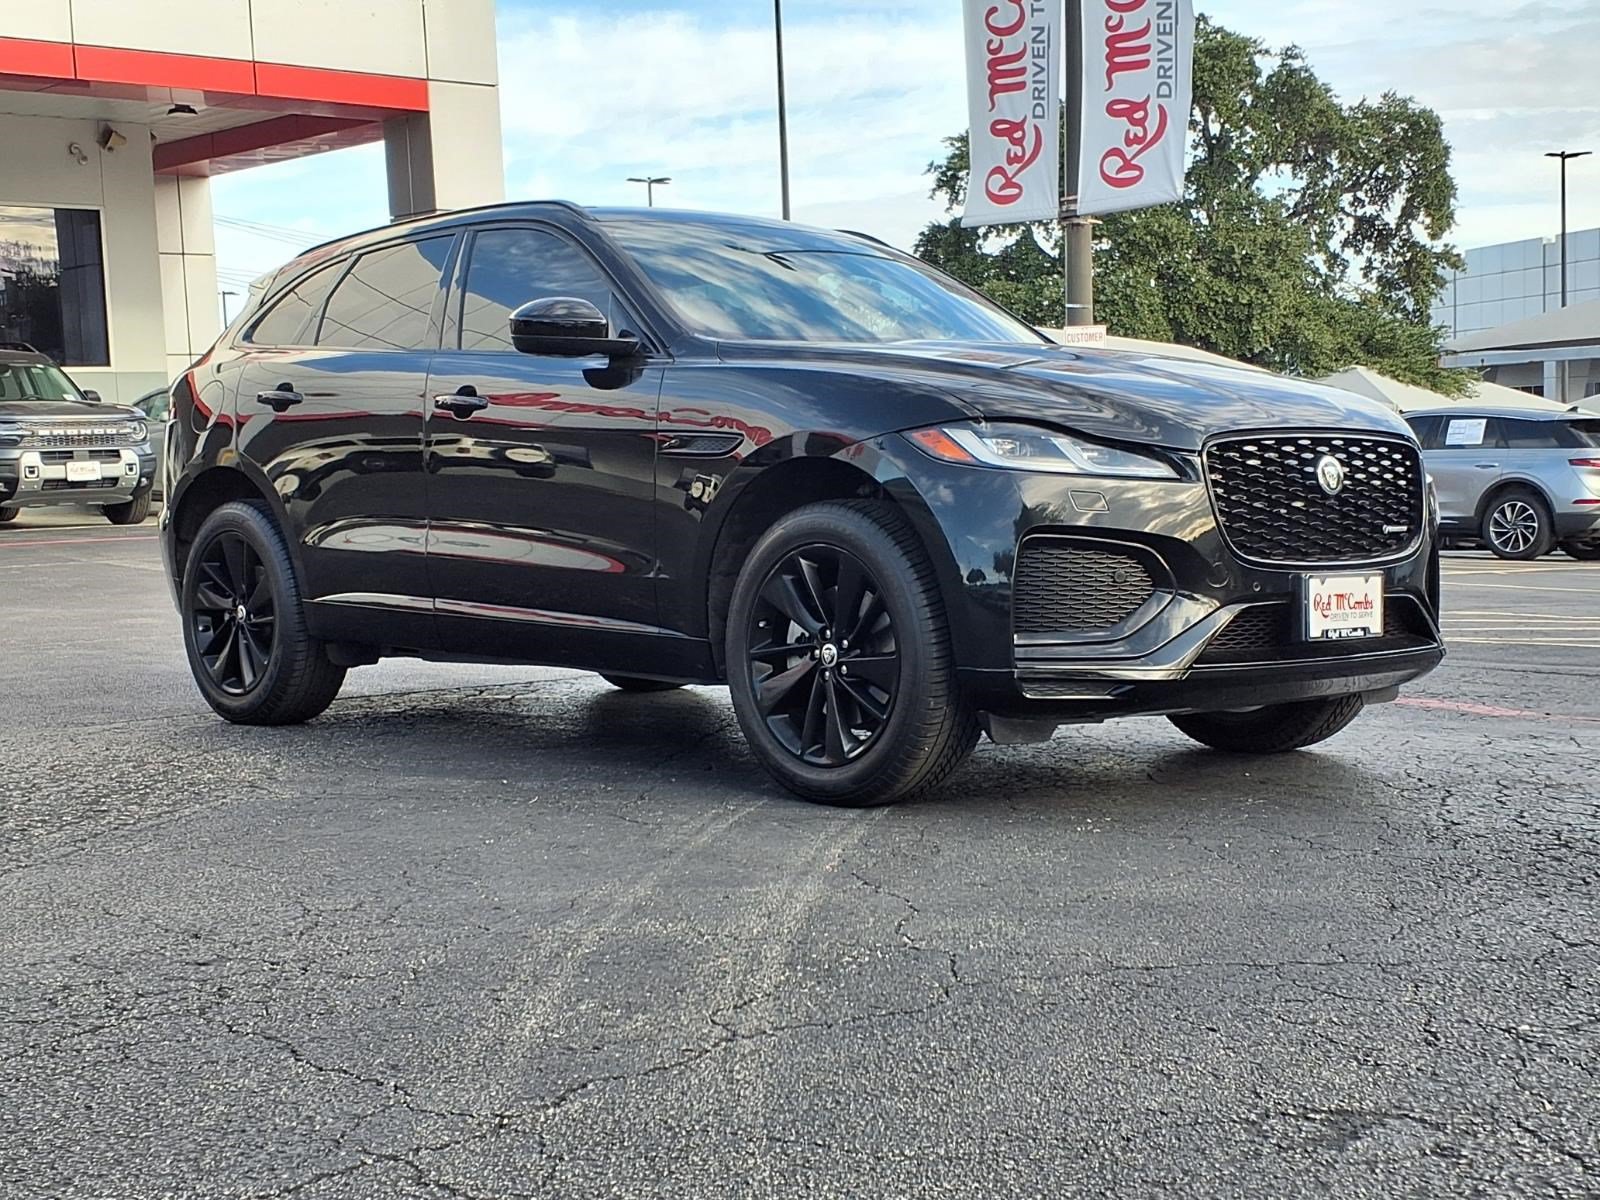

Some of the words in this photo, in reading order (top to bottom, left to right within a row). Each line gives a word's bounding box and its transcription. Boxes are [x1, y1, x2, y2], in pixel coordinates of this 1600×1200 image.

[1031, 0, 1045, 18] T
[1156, 2, 1173, 99] DRIVEN
[985, 0, 1028, 112] McC
[1031, 26, 1045, 119] DRIVEN
[985, 115, 1042, 205] Red
[1100, 94, 1168, 188] Red
[1067, 332, 1103, 343] CUSTOMER
[1313, 593, 1331, 618] Red
[1333, 592, 1373, 611] McCombs
